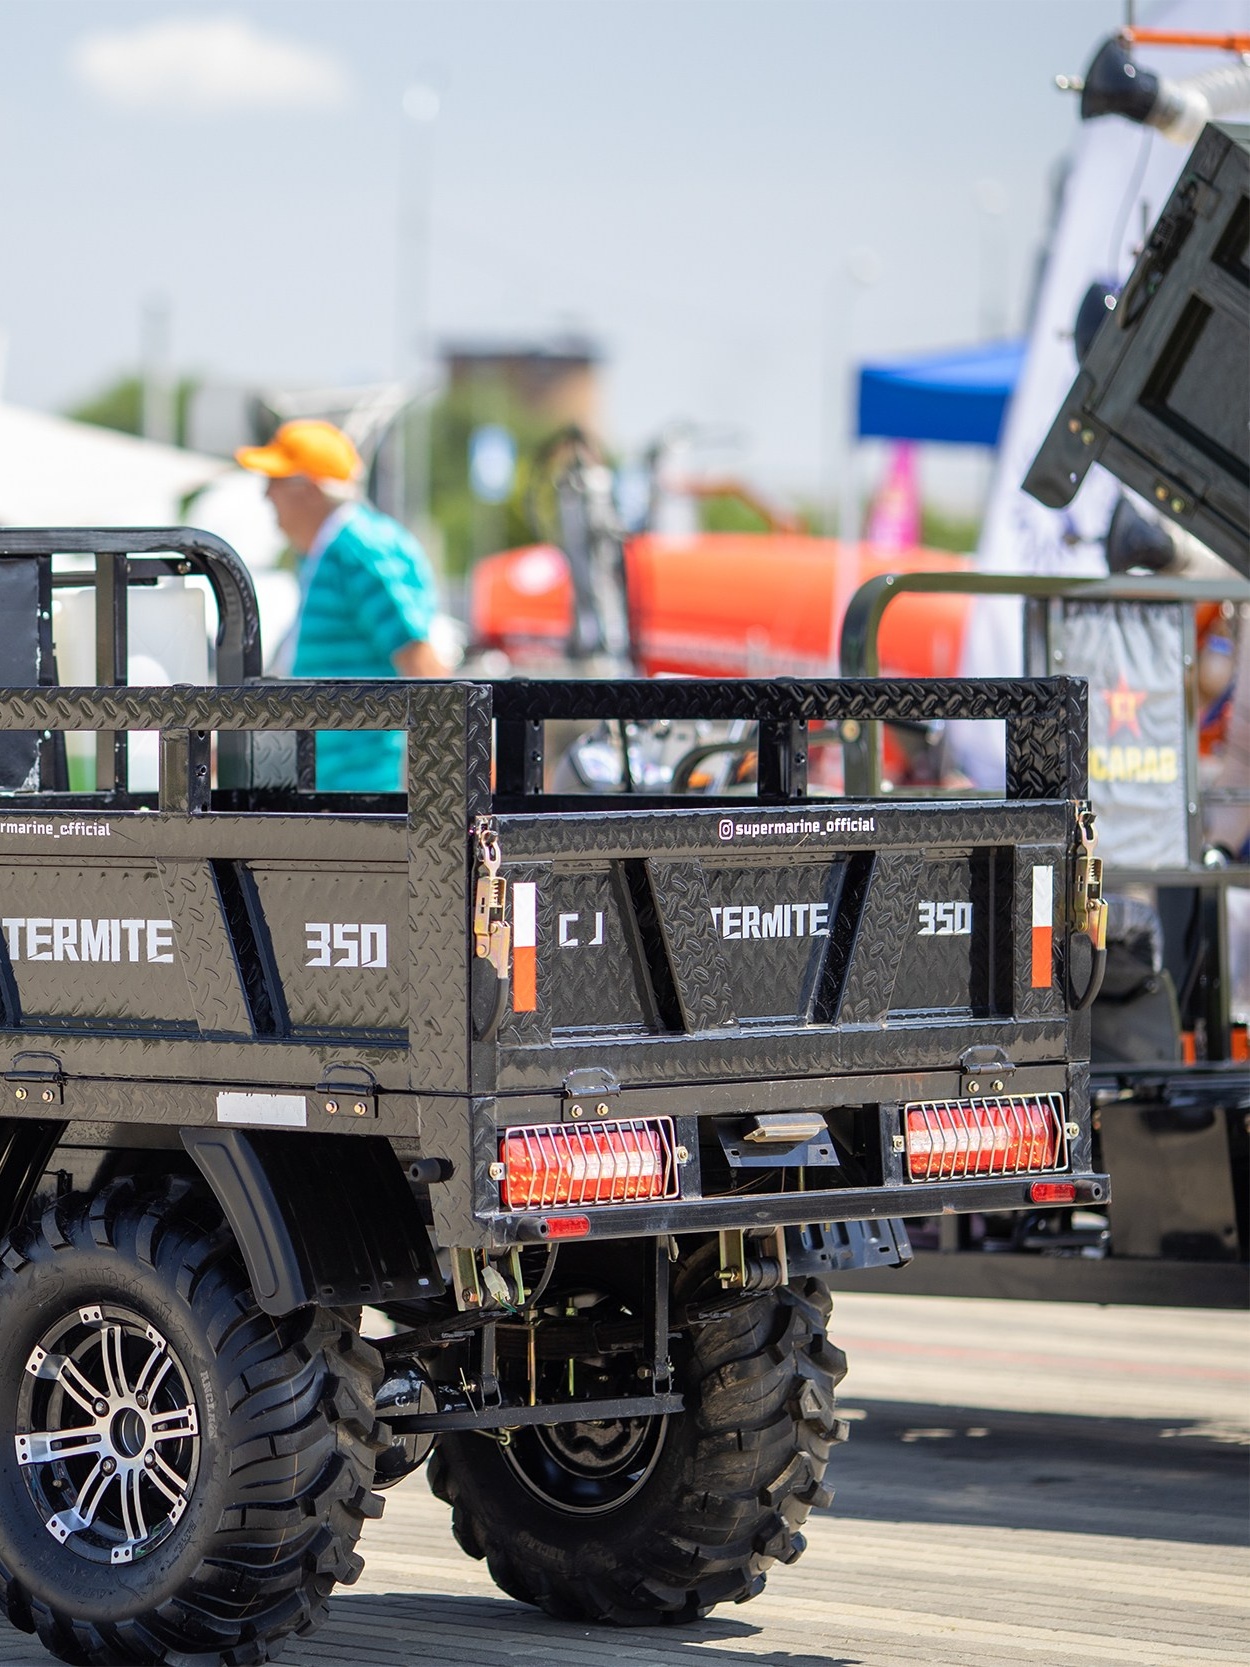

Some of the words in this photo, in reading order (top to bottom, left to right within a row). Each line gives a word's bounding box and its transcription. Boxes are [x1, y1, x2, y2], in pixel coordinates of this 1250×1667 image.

[735, 817, 875, 838] supermarine_official
[917, 901, 974, 935] 350
[1, 917, 175, 963] TERMITE
[304, 922, 388, 968] 350
